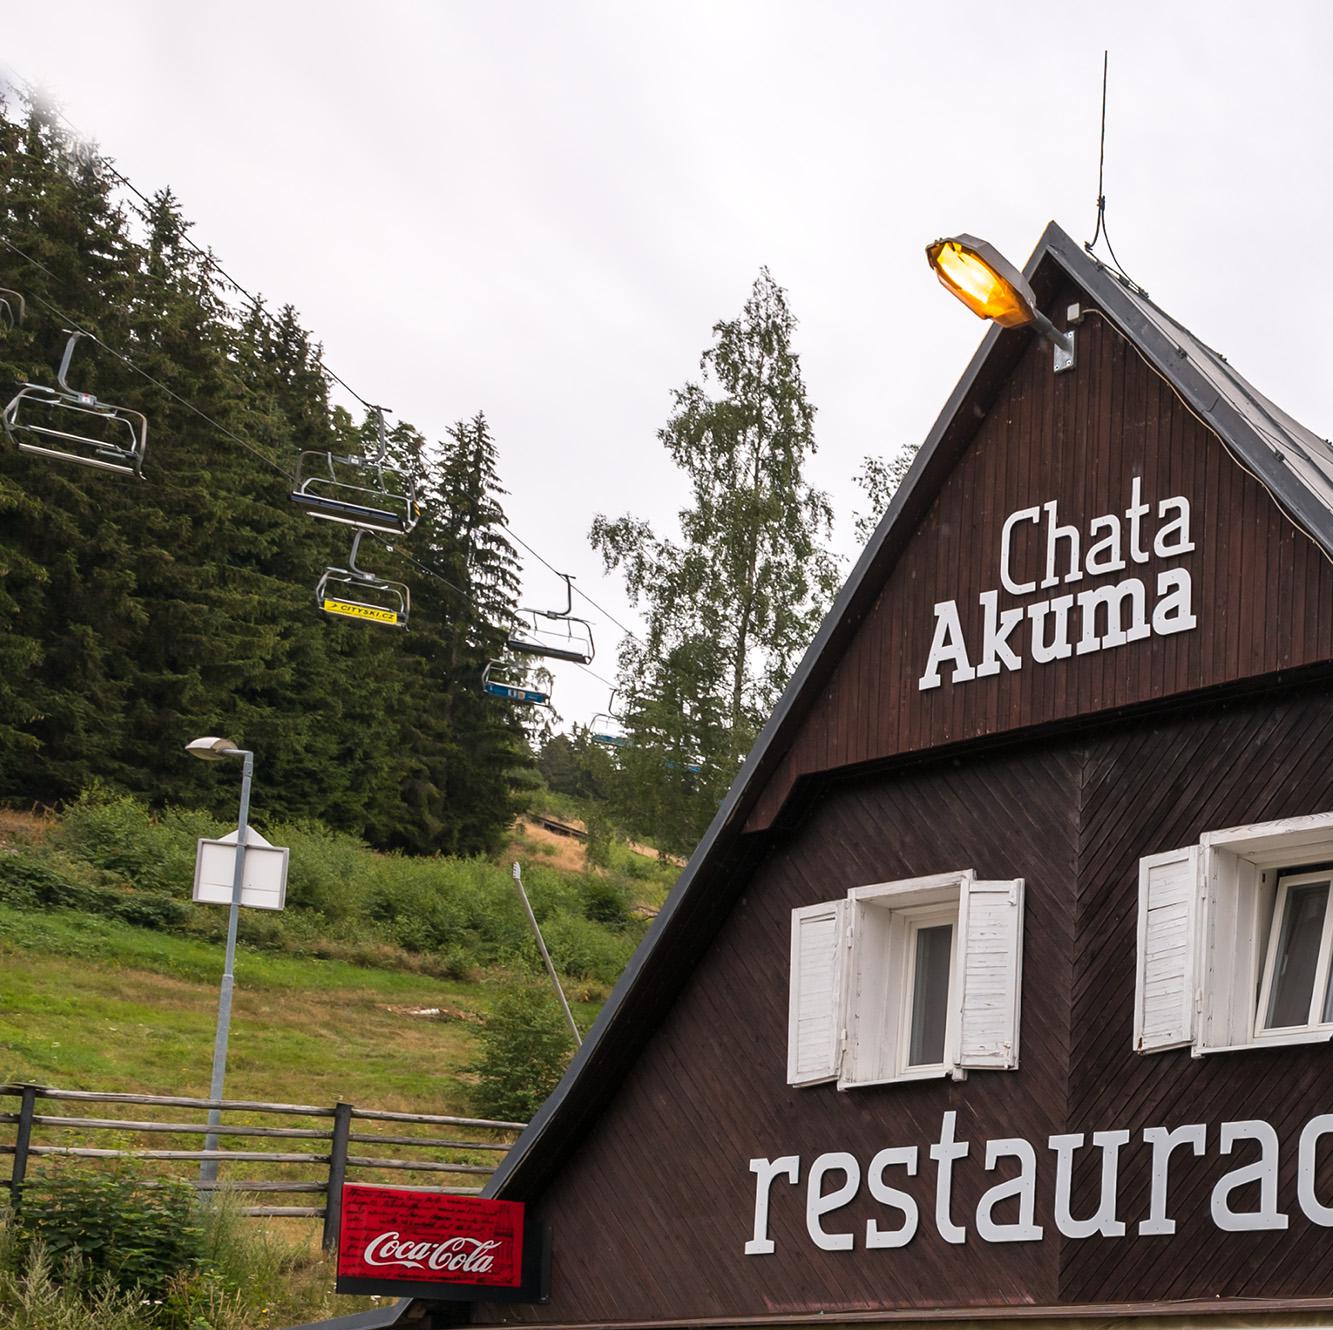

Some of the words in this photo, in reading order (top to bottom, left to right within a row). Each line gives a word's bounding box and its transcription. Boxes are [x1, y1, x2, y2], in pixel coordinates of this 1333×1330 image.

[1000, 476, 1196, 596] Chata
[340, 604, 395, 619] CITYSKI.CZ
[917, 566, 1197, 690] Akuma
[363, 1231, 503, 1273] Coca-Cola
